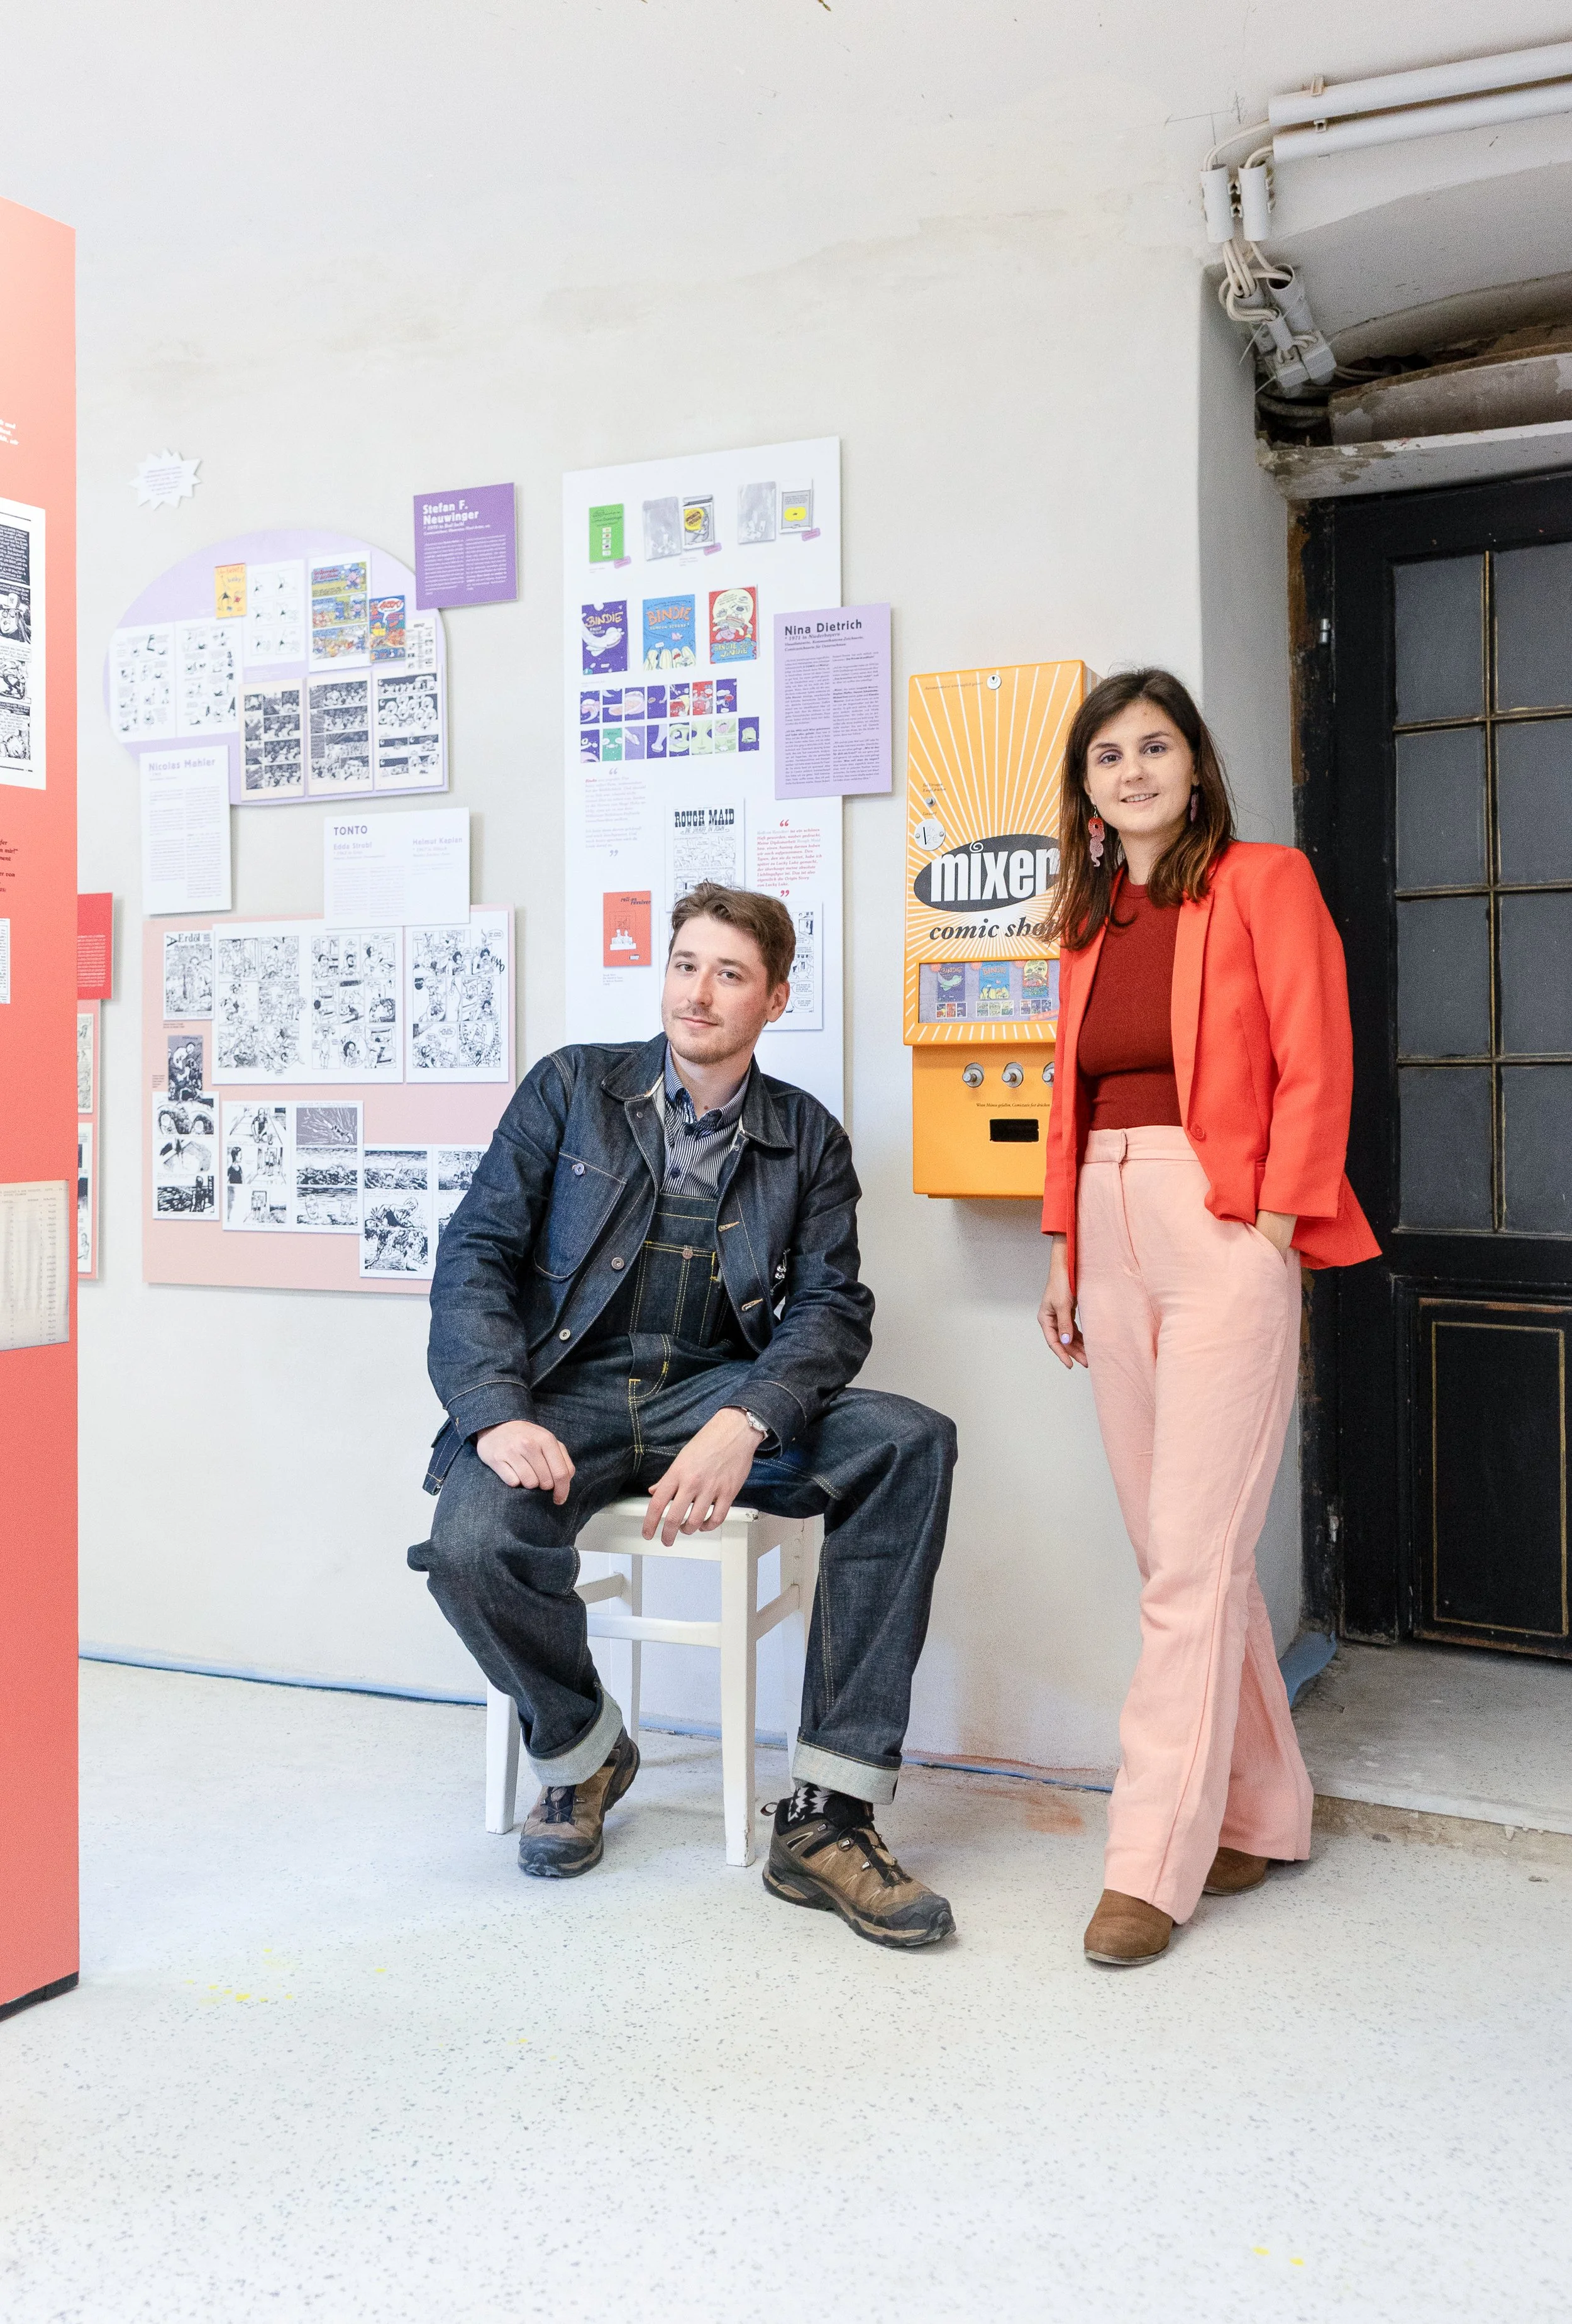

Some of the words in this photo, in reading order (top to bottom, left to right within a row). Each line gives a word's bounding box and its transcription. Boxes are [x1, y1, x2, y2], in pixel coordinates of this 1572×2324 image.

[423, 503, 455, 514] Stefan
[458, 499, 468, 510] F.
[423, 511, 479, 525] Neuwinger
[785, 626, 811, 635] Nina
[817, 620, 861, 632] Dietrich
[148, 762, 180, 772] Nicolas
[184, 758, 215, 767] Mahler
[675, 810, 704, 827] ROUGH
[709, 809, 734, 826] MAID
[334, 825, 367, 836] TONTO
[931, 840, 1061, 903] mixer
[929, 918, 1000, 940] comic
[177, 933, 200, 942] Erdöl
